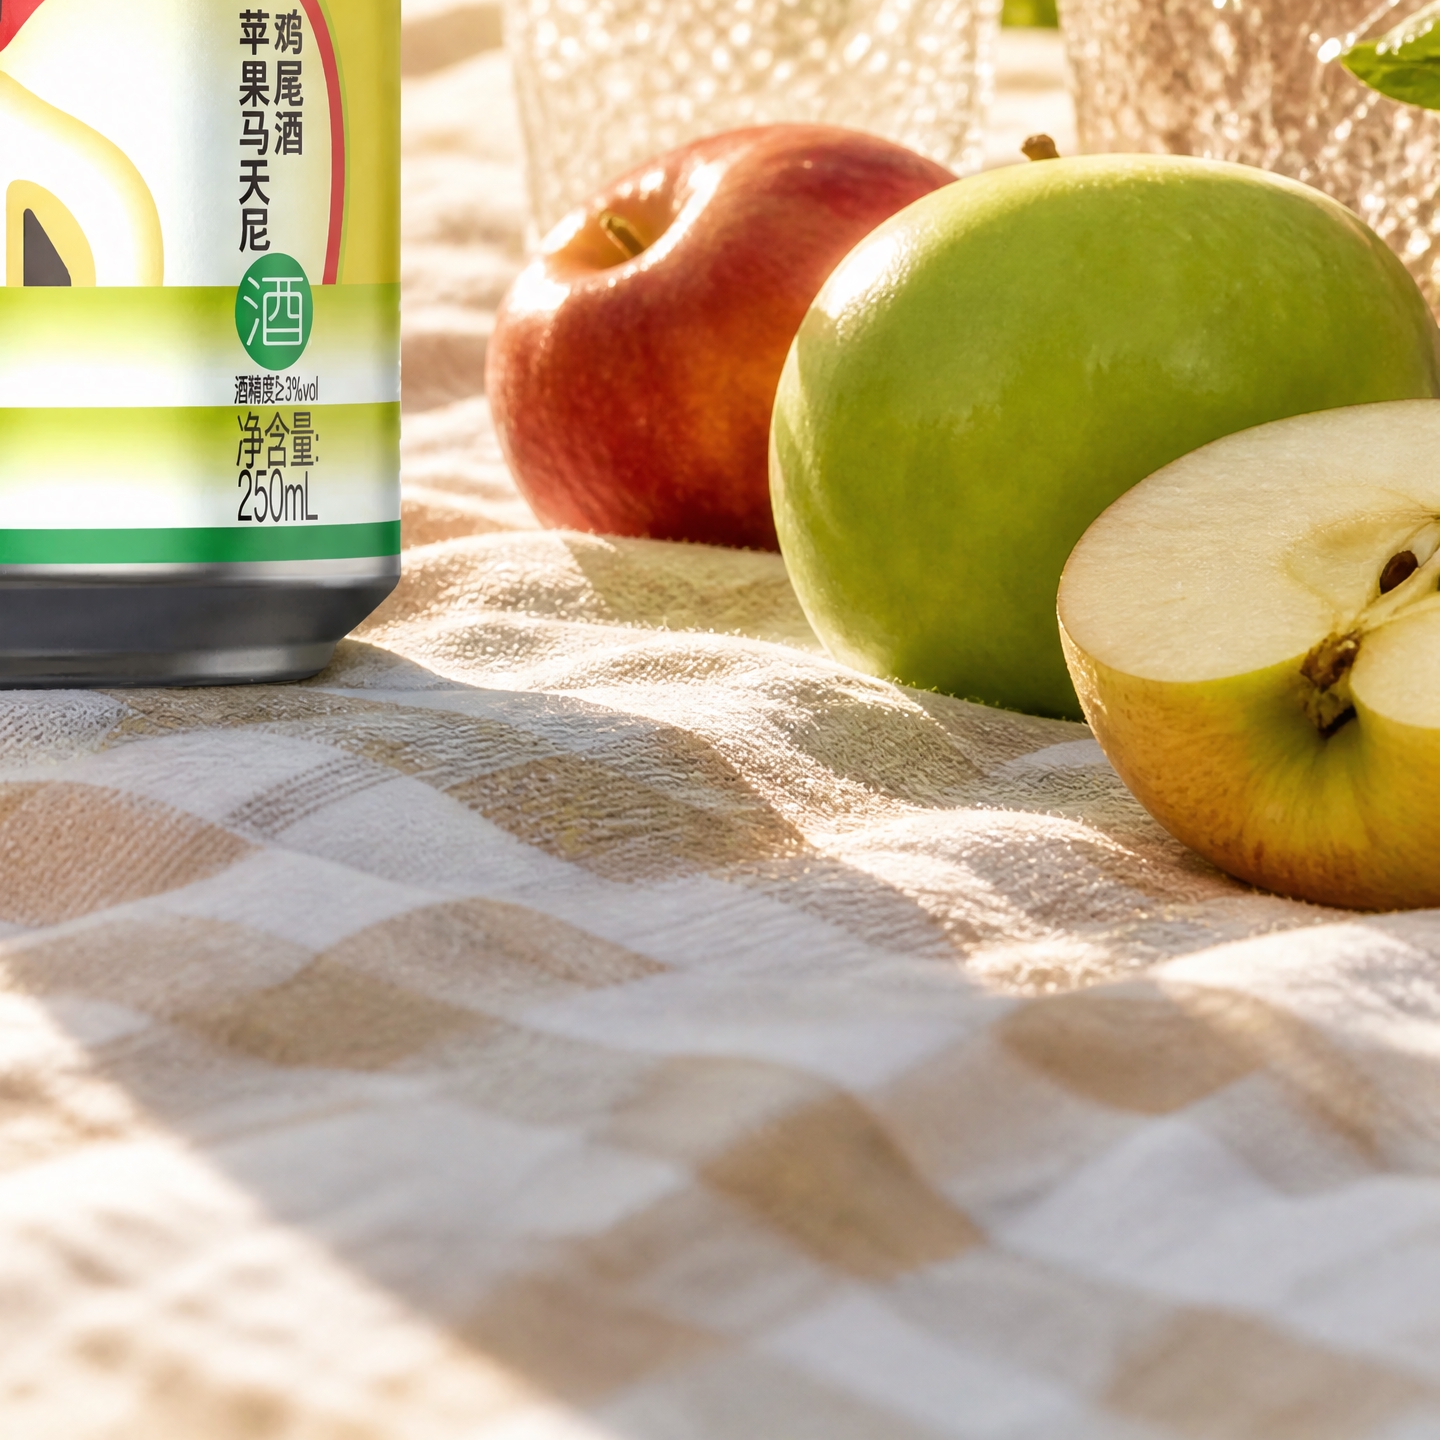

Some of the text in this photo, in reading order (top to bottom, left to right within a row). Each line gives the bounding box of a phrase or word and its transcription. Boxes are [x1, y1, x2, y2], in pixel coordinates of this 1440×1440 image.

[238, 9, 271, 253] 苹果马天尼
[243, 276, 304, 346] 酒
[237, 468, 319, 523] 250mL
